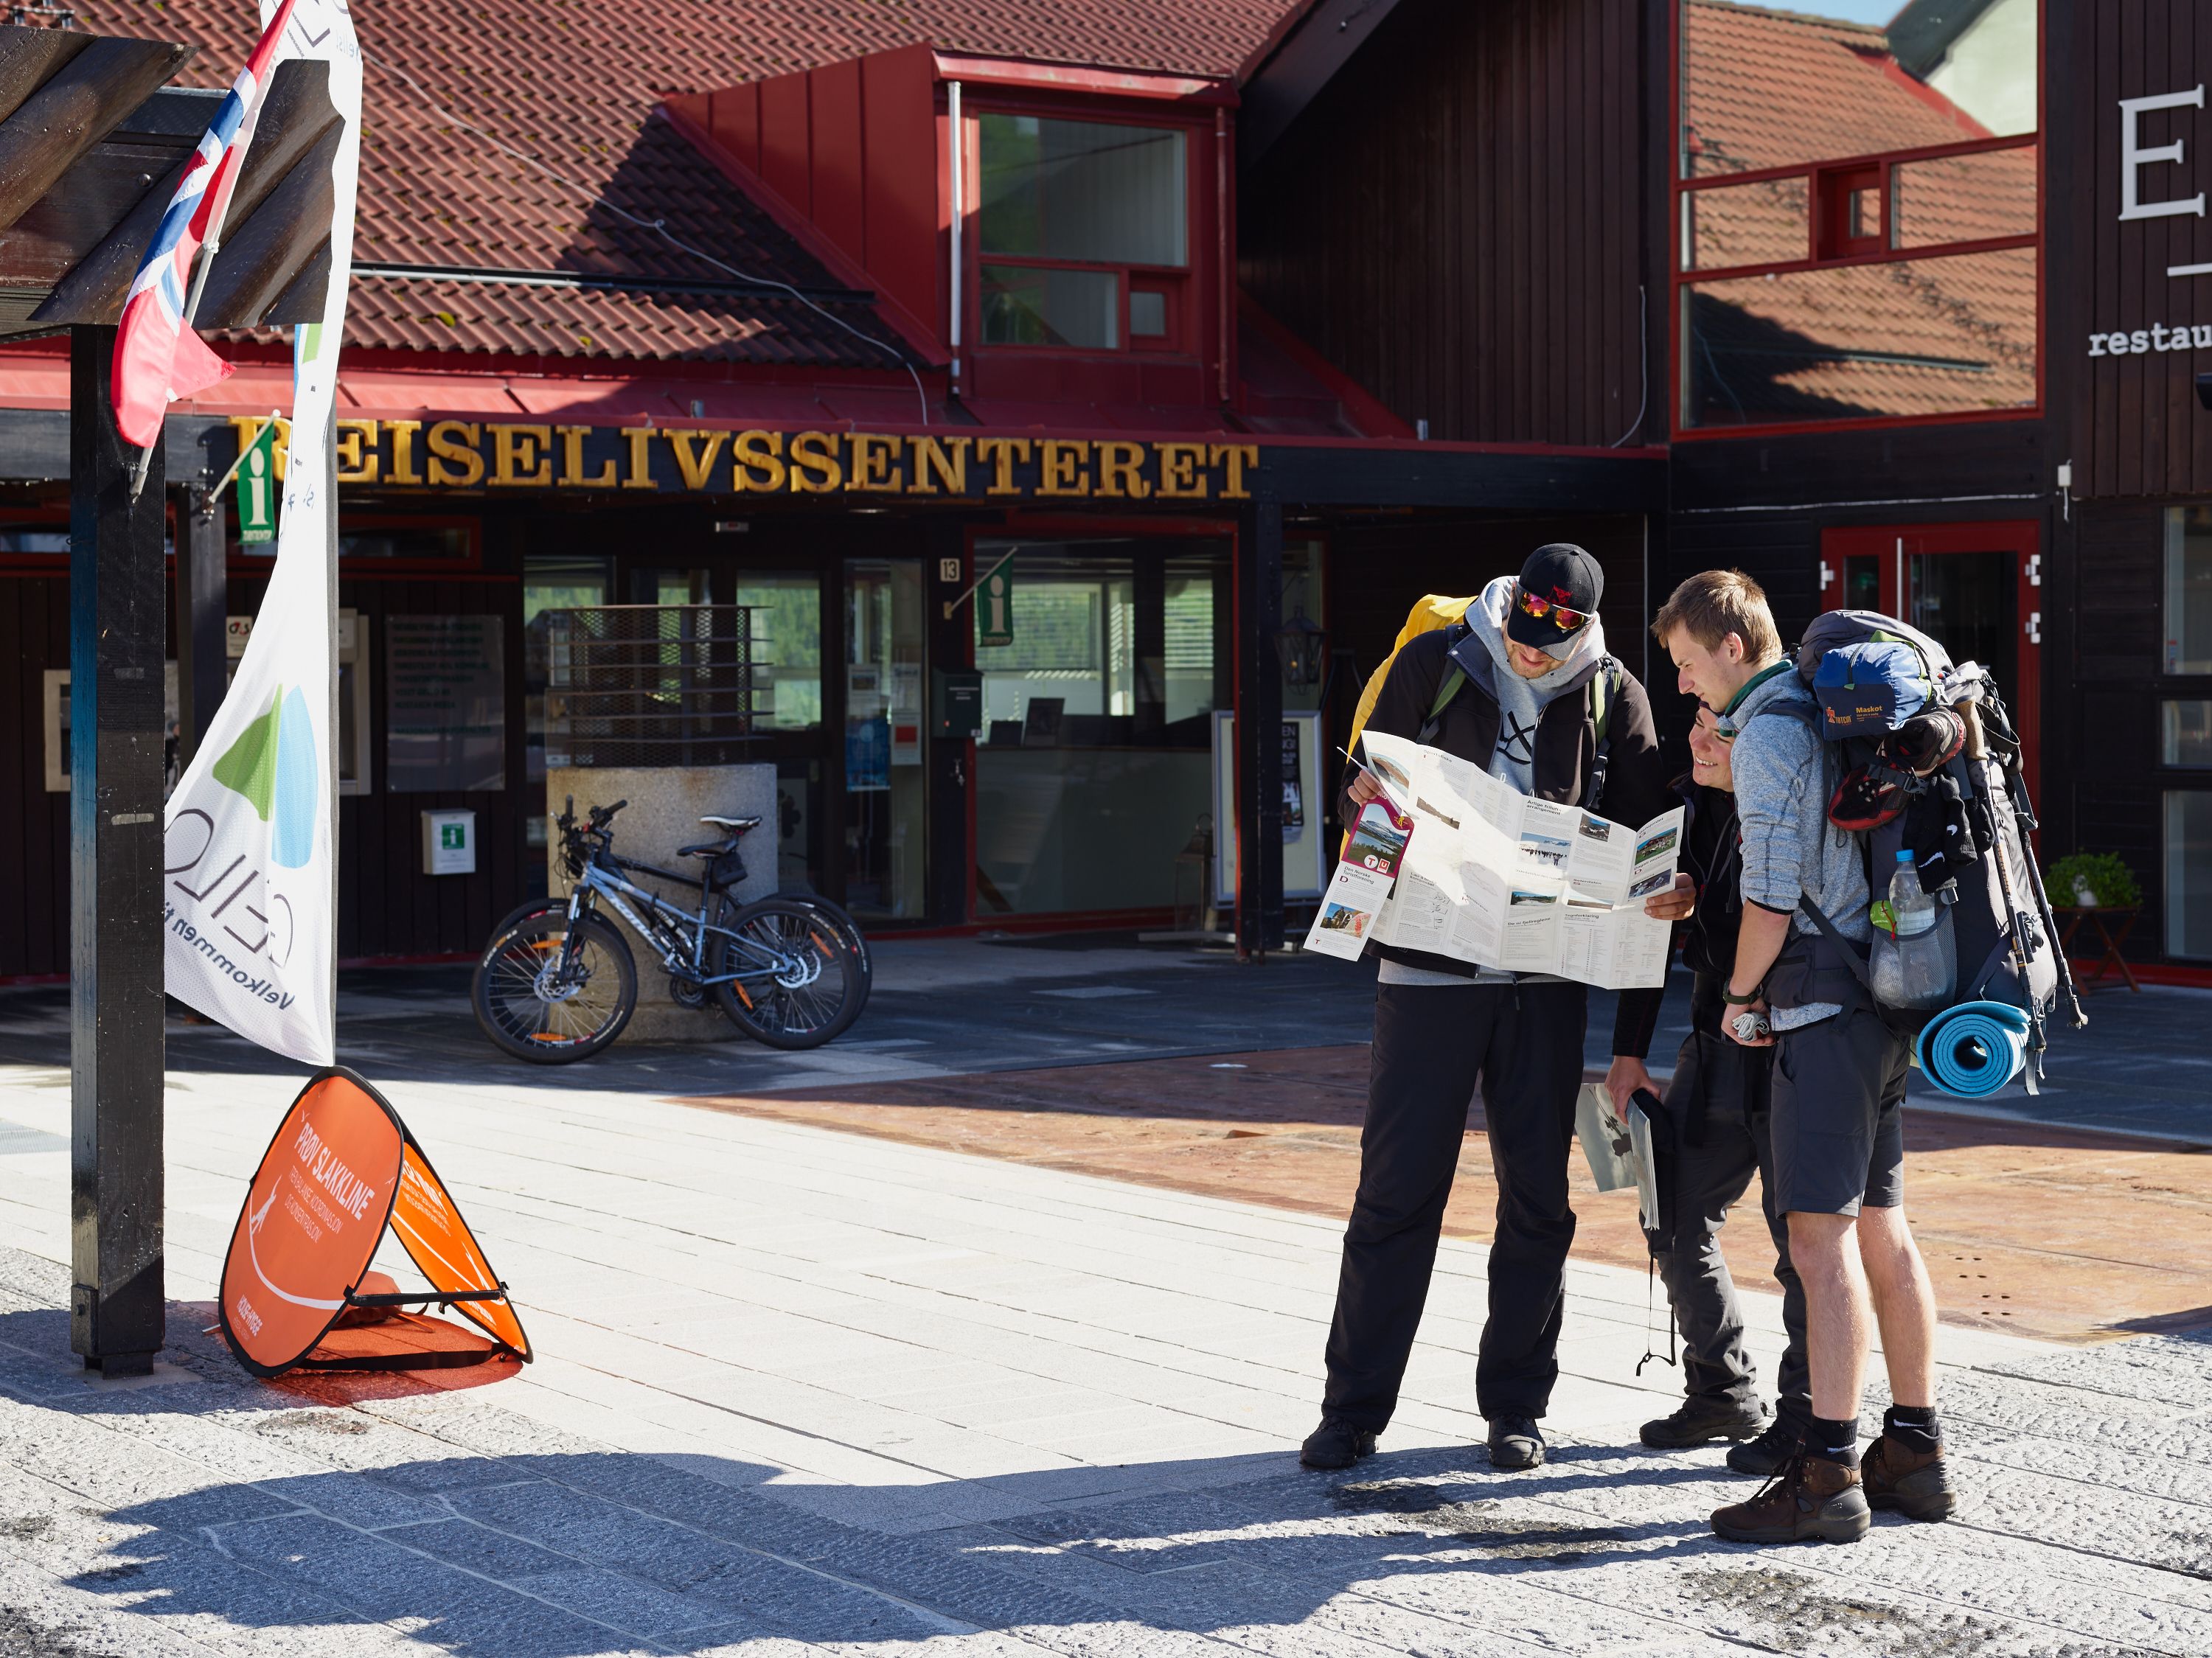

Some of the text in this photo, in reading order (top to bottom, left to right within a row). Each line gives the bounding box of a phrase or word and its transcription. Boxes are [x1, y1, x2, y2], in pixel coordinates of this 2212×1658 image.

[2118, 83, 2206, 221] E
[2087, 322, 2212, 357] restau
[942, 560, 957, 579] 13
[1856, 705, 1883, 713] Maskot
[1343, 870, 1374, 885] Turistforening
[1354, 868, 1371, 878] Norske
[294, 1122, 375, 1221] PRØV SLAKKLINE
